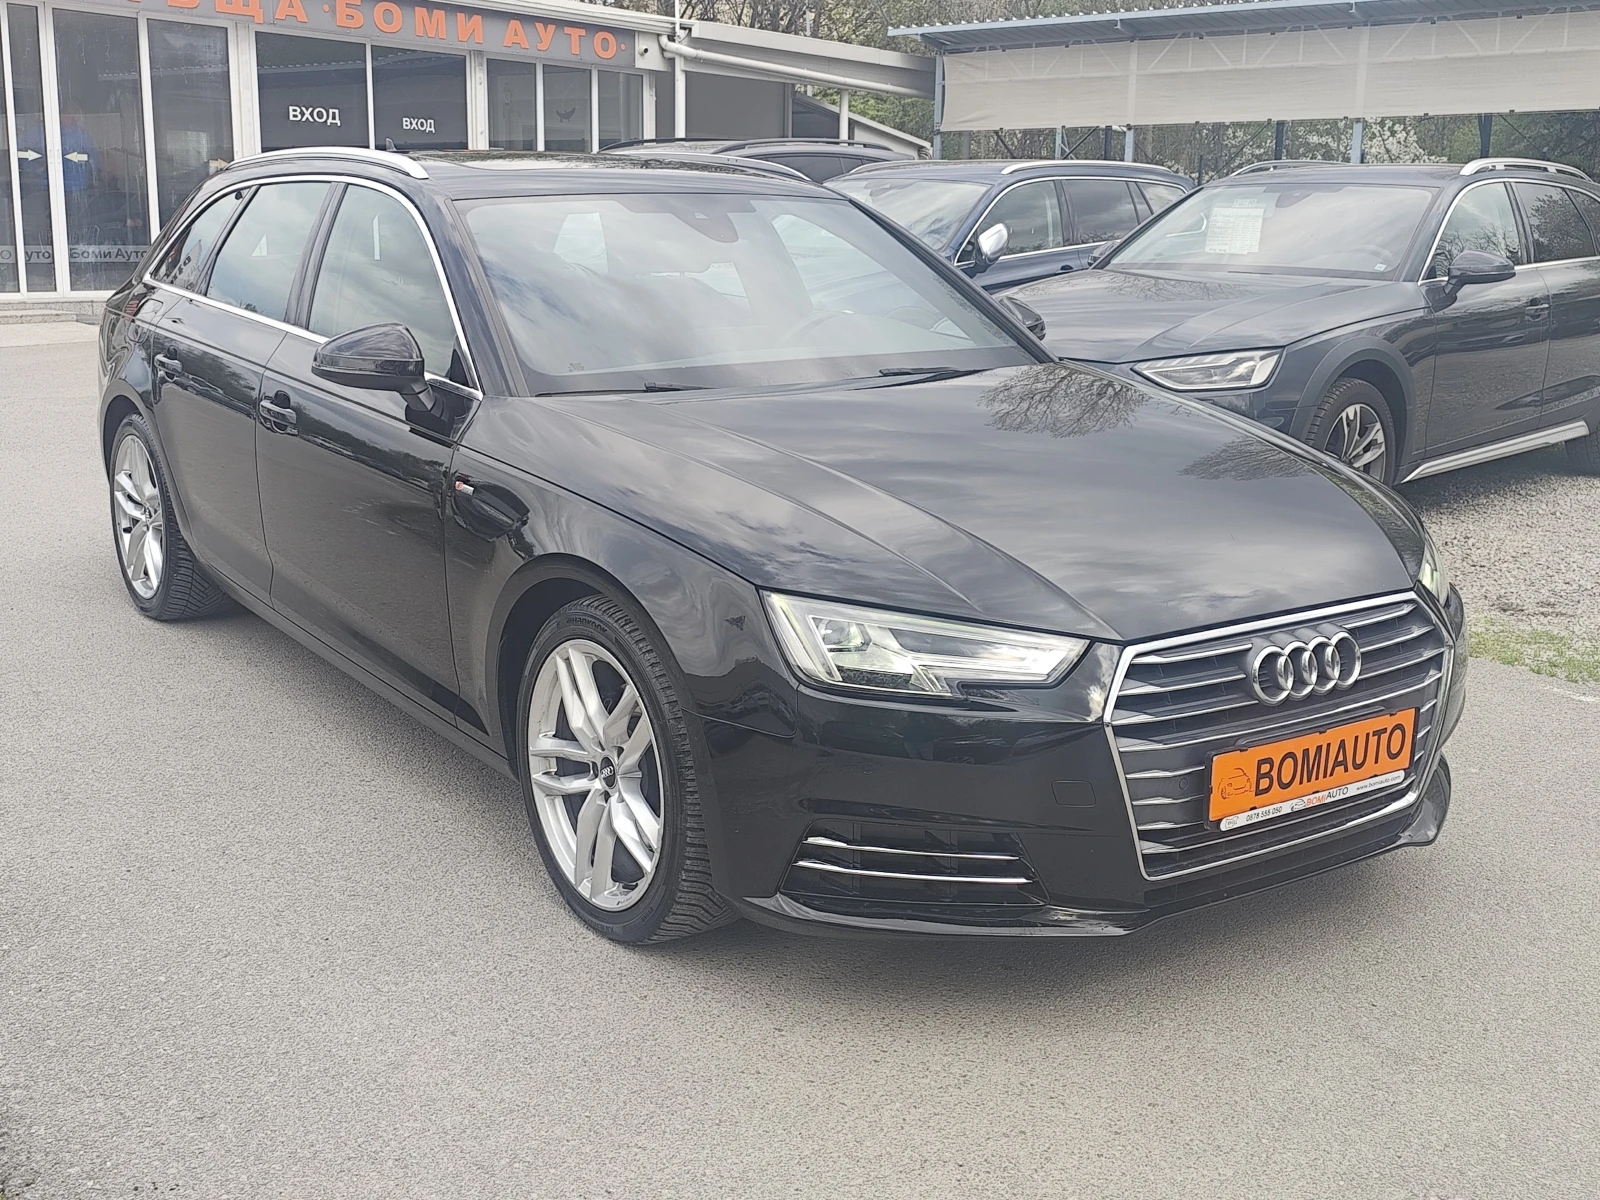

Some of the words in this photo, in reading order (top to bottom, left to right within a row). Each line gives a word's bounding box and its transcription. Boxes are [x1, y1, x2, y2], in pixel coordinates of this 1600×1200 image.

[127, 0, 308, 23] ЩА
[336, 0, 483, 44] БОМИ
[503, 19, 617, 59] АУТО
[288, 106, 341, 127] ВХОД
[402, 117, 435, 133] ВХОД
[25, 250, 51, 262] уто
[1254, 723, 1406, 796] BOMIAUTO
[1306, 786, 1349, 806] BOMIAUTO
[1356, 775, 1401, 791] www.bomiauto.com
